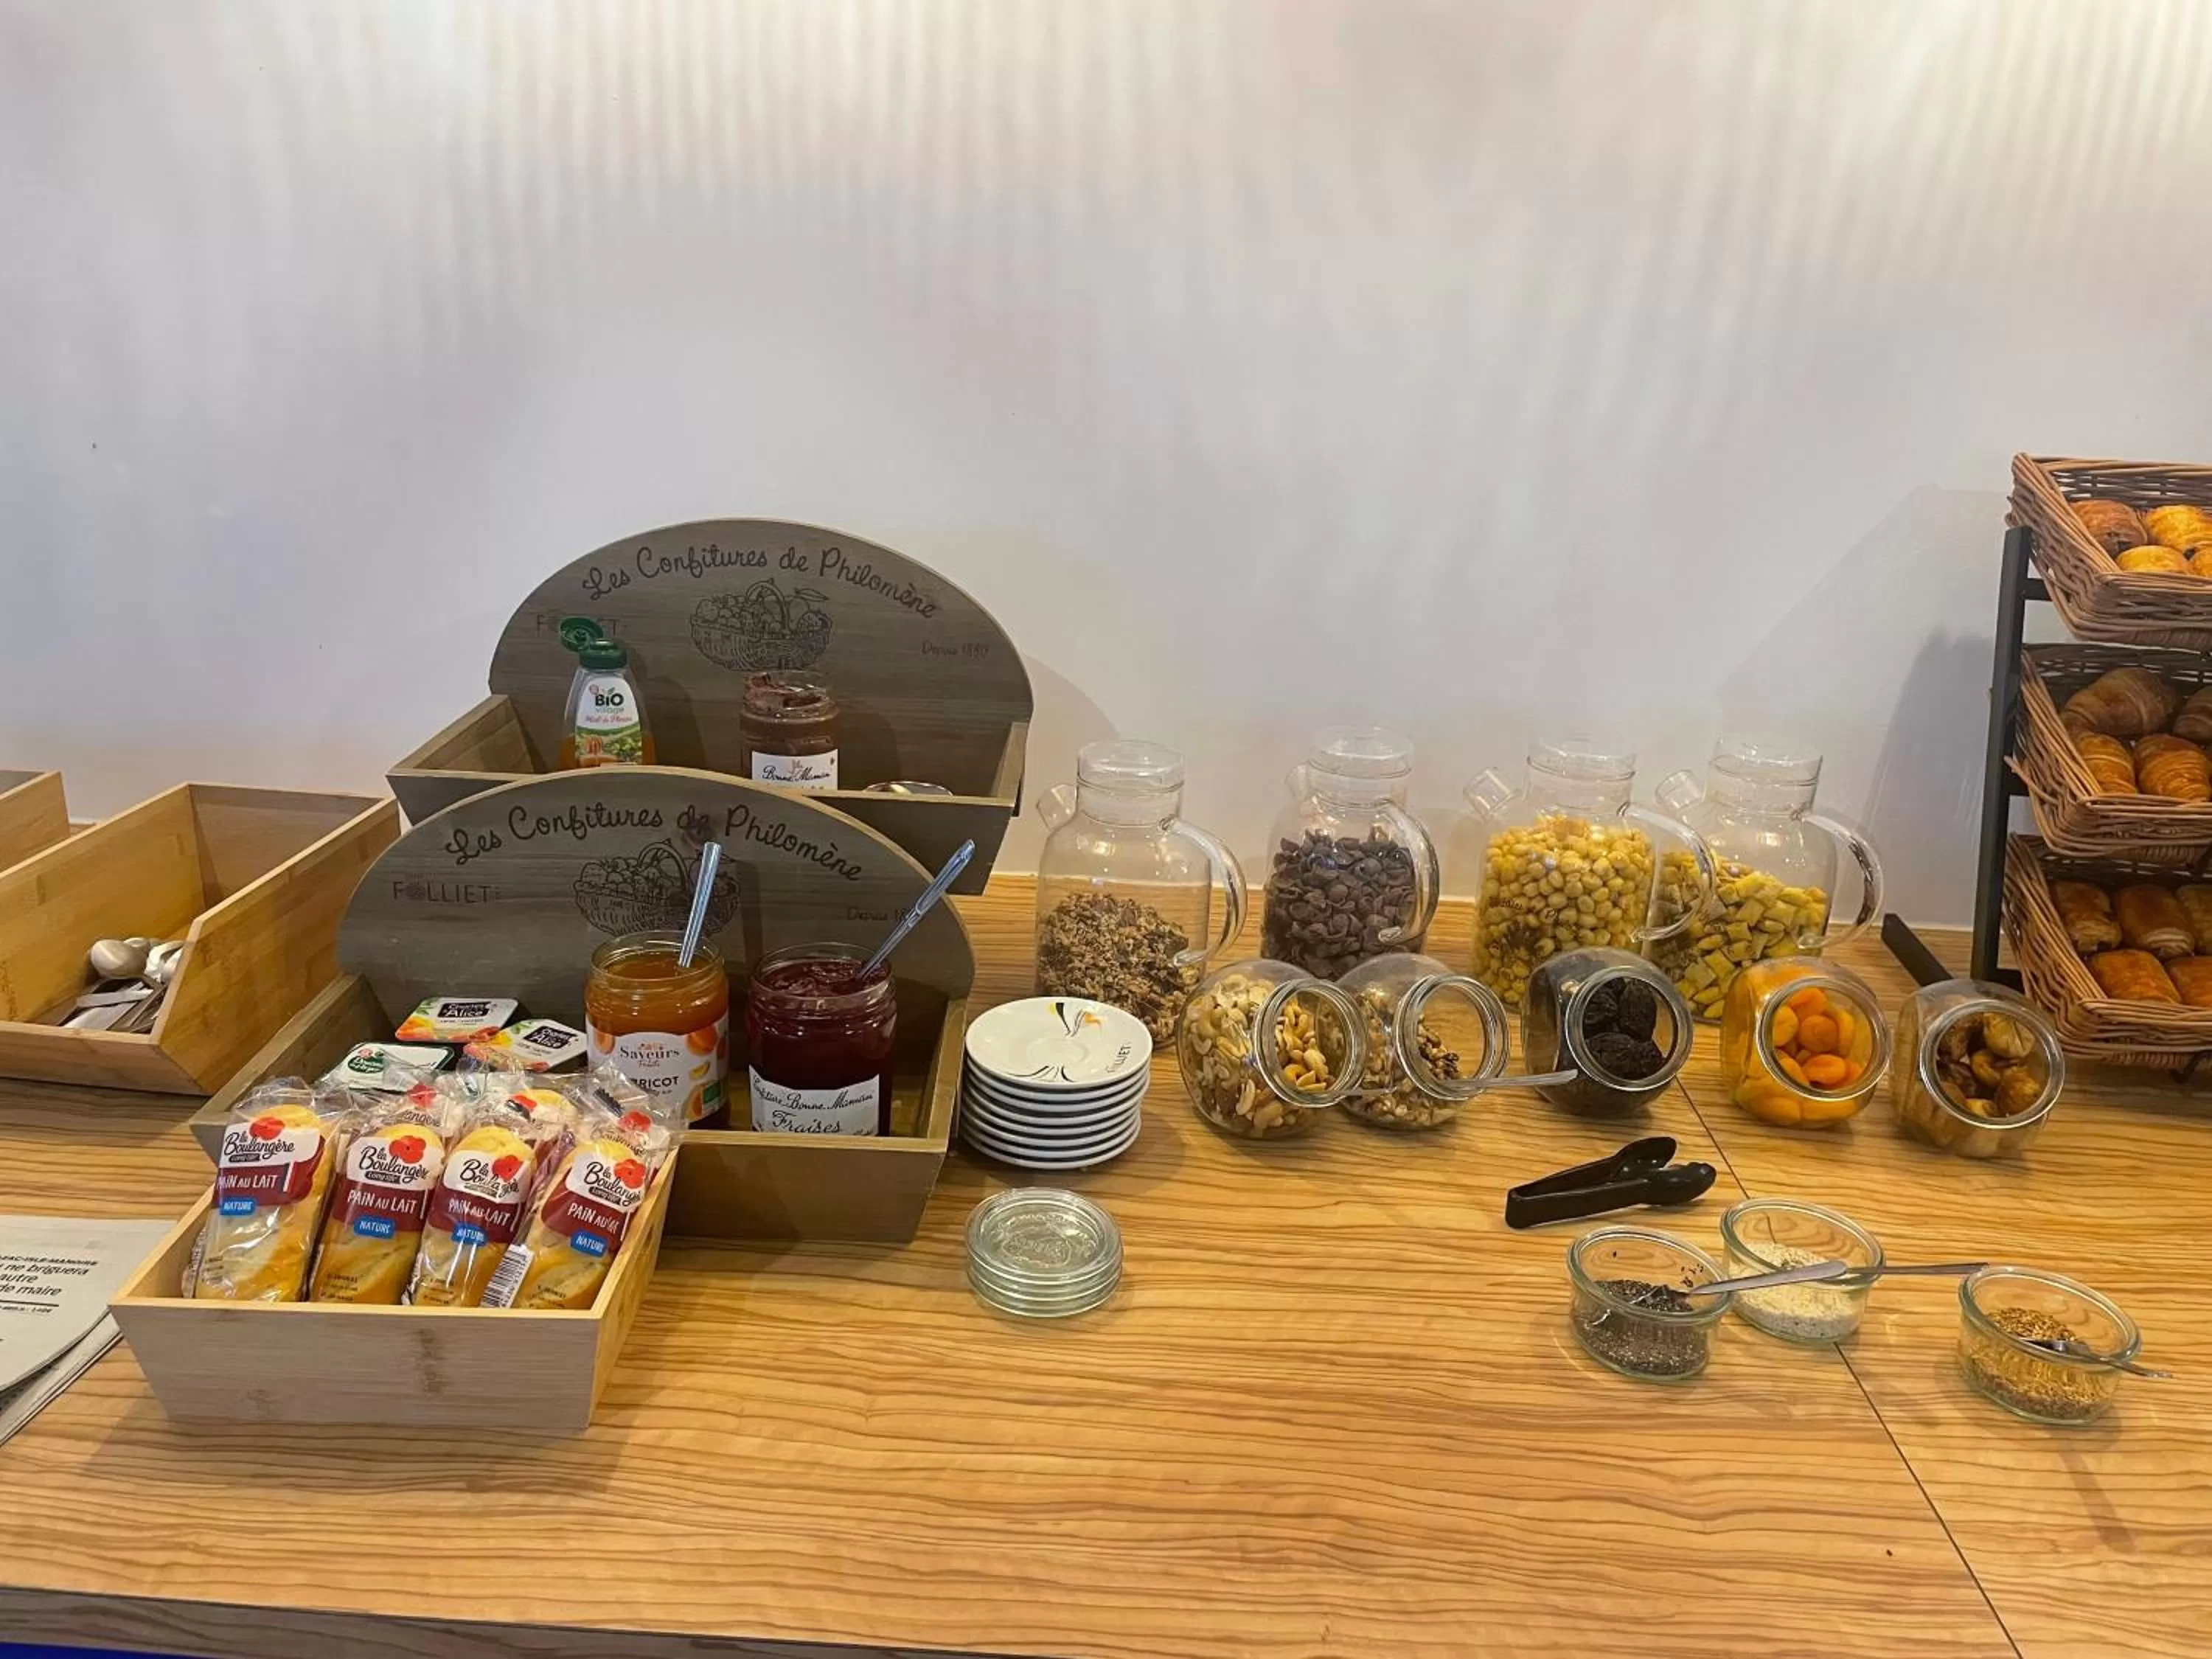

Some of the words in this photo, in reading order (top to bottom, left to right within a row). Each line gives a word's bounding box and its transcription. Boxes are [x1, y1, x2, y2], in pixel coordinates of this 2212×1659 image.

[582, 566, 631, 601] Les
[636, 544, 768, 578] Confitures
[779, 546, 808, 572] de
[819, 546, 935, 618] Philomène
[445, 828, 502, 866] Les
[509, 801, 662, 841] Confitures
[724, 804, 862, 881] Philomène
[619, 1046, 681, 1060] Saveurs
[772, 1110, 841, 1133] Fraises
[223, 1132, 295, 1160] Boulangère
[252, 1175, 278, 1189] LAIT
[375, 1197, 389, 1210] AU
[390, 1197, 419, 1214] LAIT
[567, 1203, 597, 1225] PAIN
[27, 1264, 89, 1275] briguera
[15, 1286, 62, 1295] maire
